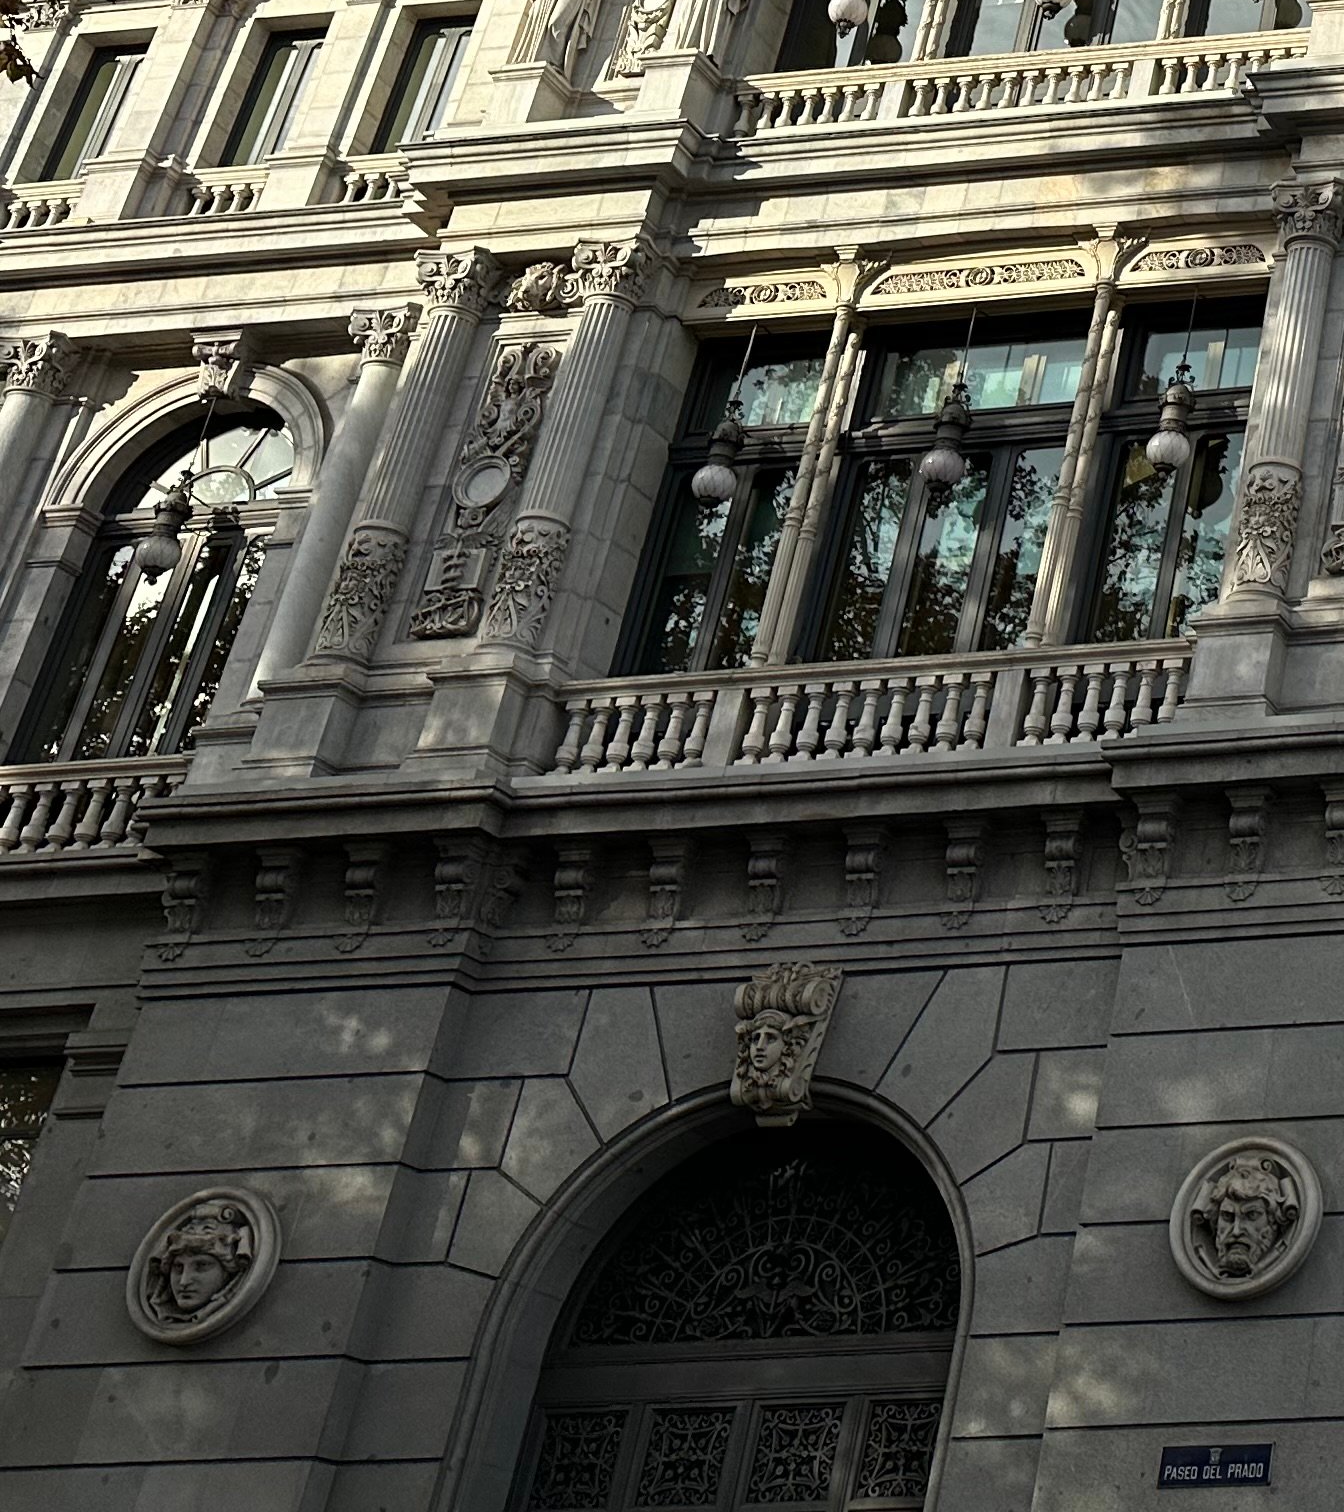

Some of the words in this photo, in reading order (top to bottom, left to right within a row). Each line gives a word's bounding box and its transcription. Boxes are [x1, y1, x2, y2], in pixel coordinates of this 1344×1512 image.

[1164, 1465, 1198, 1480] PASEO
[1202, 1465, 1222, 1480] DEL
[1227, 1463, 1264, 1478] PRADO
